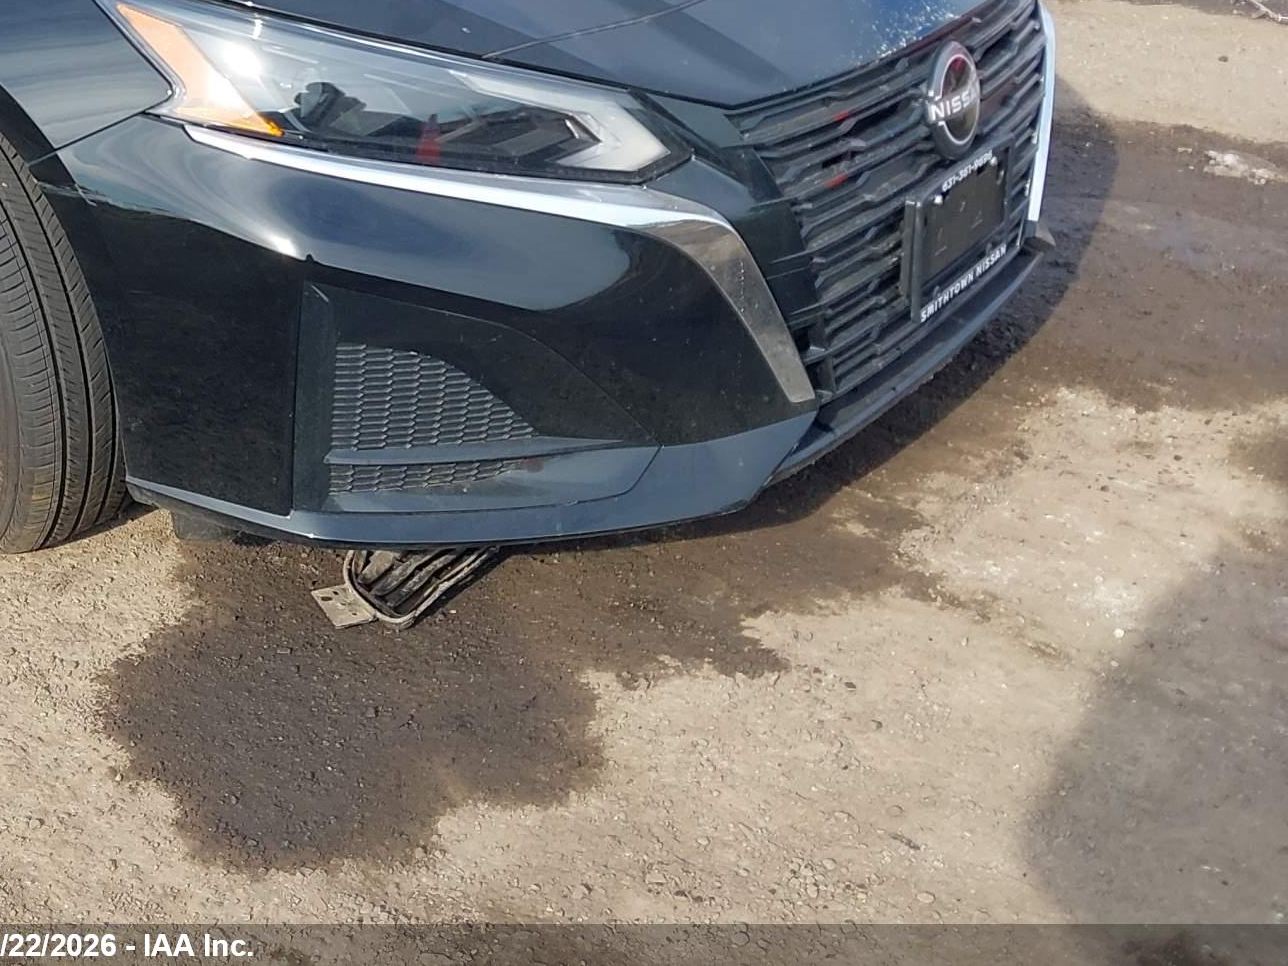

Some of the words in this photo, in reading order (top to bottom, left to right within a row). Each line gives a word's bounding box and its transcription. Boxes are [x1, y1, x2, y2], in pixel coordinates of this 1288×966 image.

[929, 88, 979, 122] NISSA
[920, 269, 974, 323] SMITHTOWN
[975, 242, 1007, 277] NISSAN
